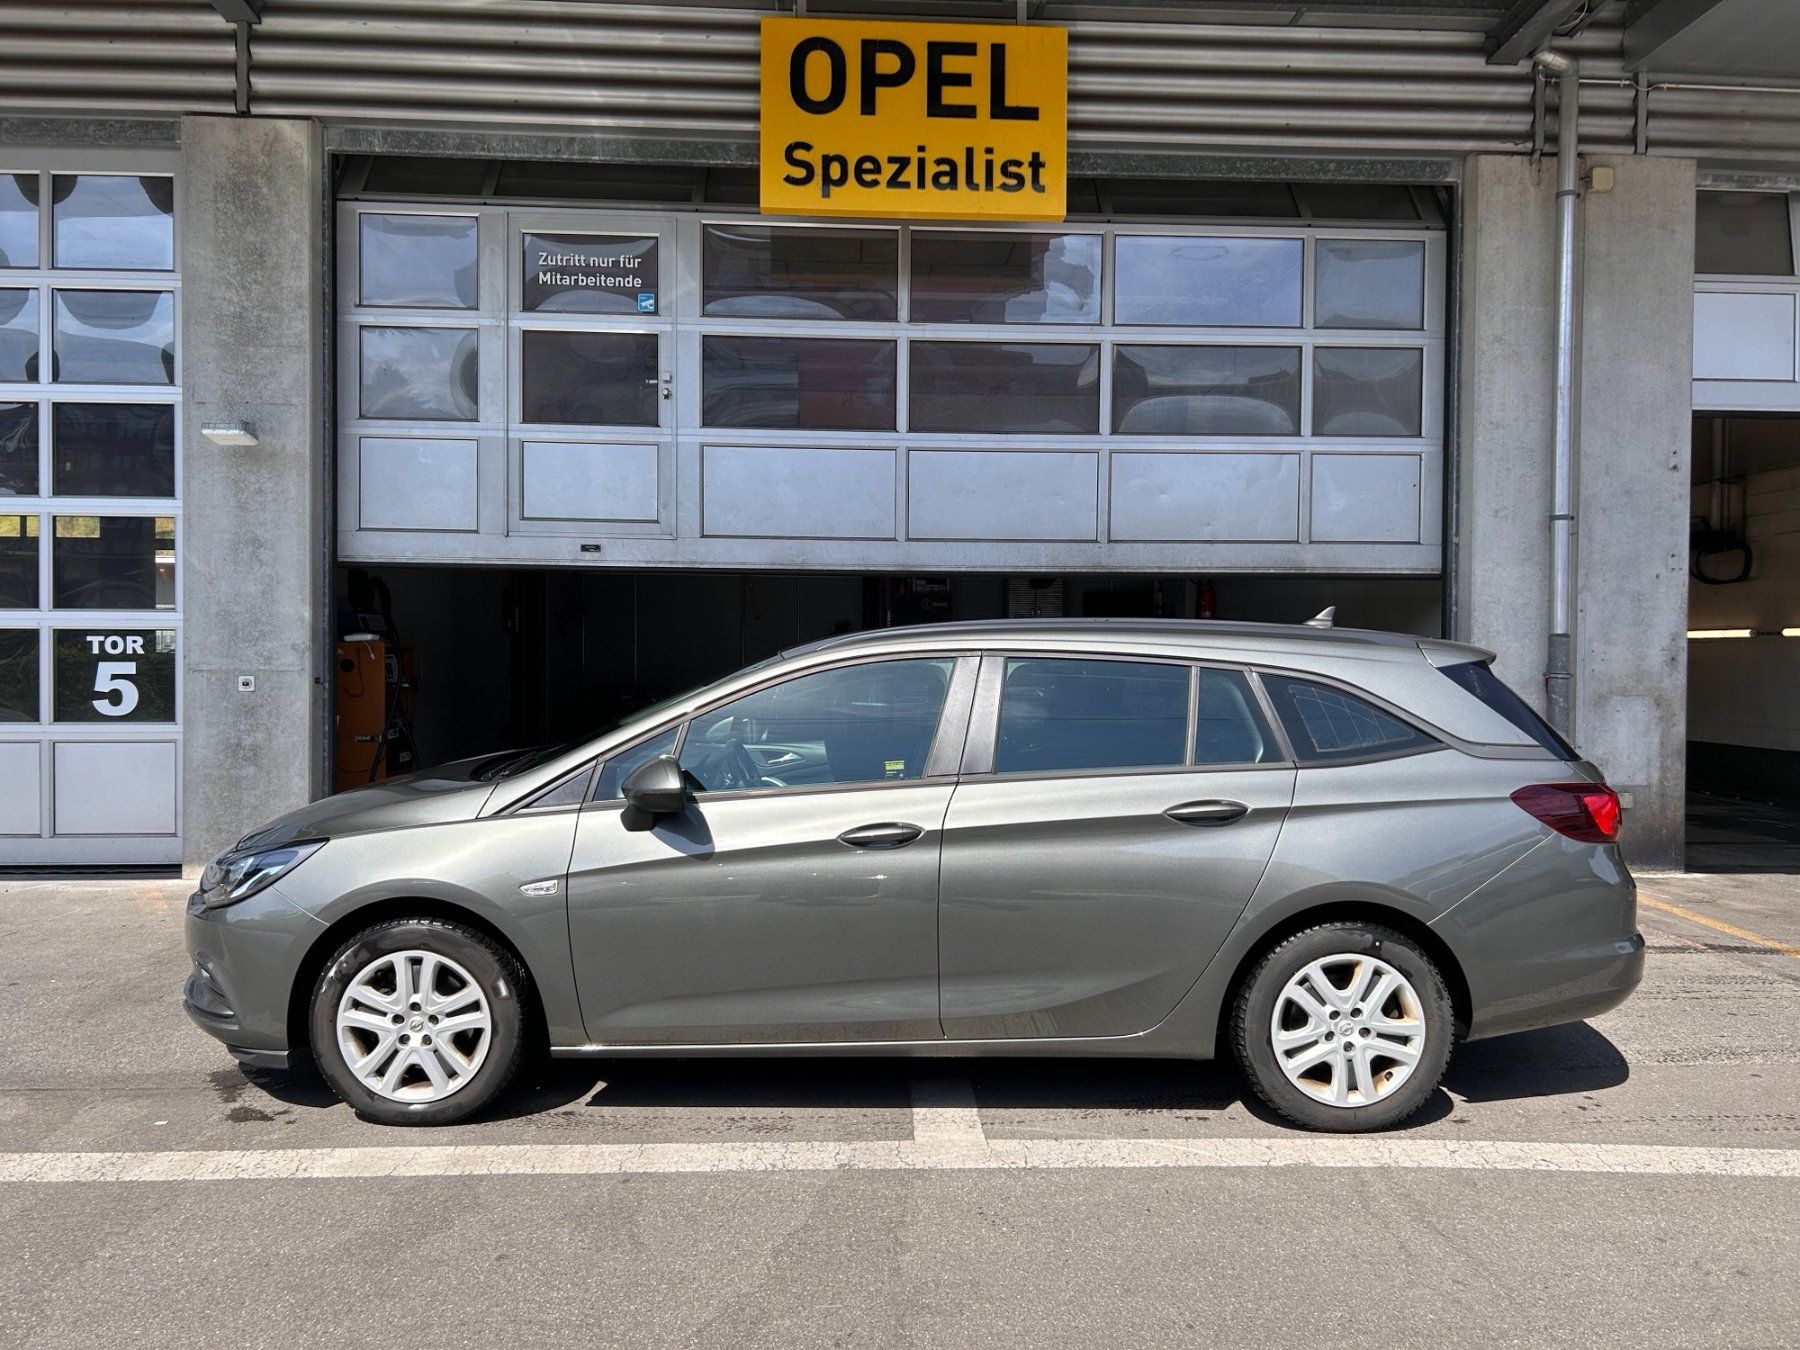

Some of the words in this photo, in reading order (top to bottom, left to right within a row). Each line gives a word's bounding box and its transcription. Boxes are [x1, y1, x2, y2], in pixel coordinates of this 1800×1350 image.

[789, 36, 1039, 121] OPEL
[783, 141, 1046, 199] Spezialist
[538, 252, 586, 266] Zutritt
[589, 257, 615, 268] nur
[619, 254, 642, 268] für
[538, 271, 642, 288] Mitarbeitende
[86, 635, 145, 654] TOR
[91, 661, 139, 717] 5
